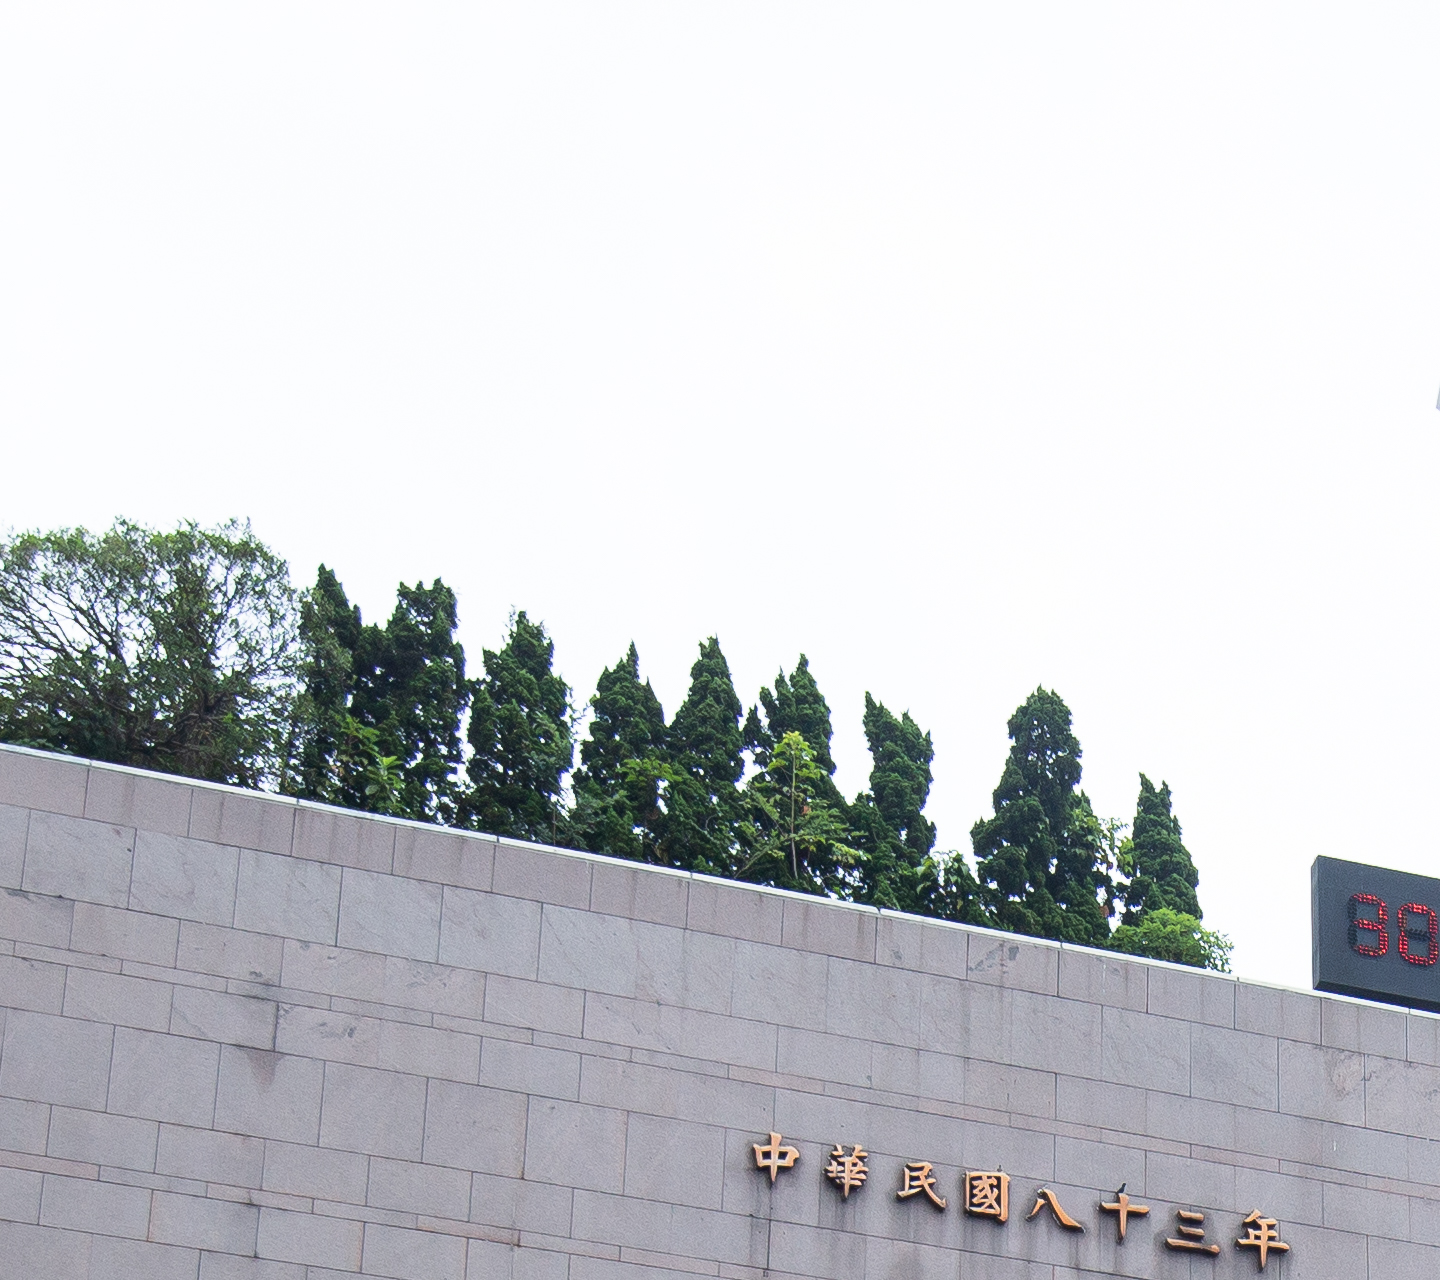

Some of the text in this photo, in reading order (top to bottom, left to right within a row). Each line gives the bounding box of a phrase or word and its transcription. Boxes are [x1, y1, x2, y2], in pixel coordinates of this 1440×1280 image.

[751, 1131, 1290, 1272] 中華民國八十三年
